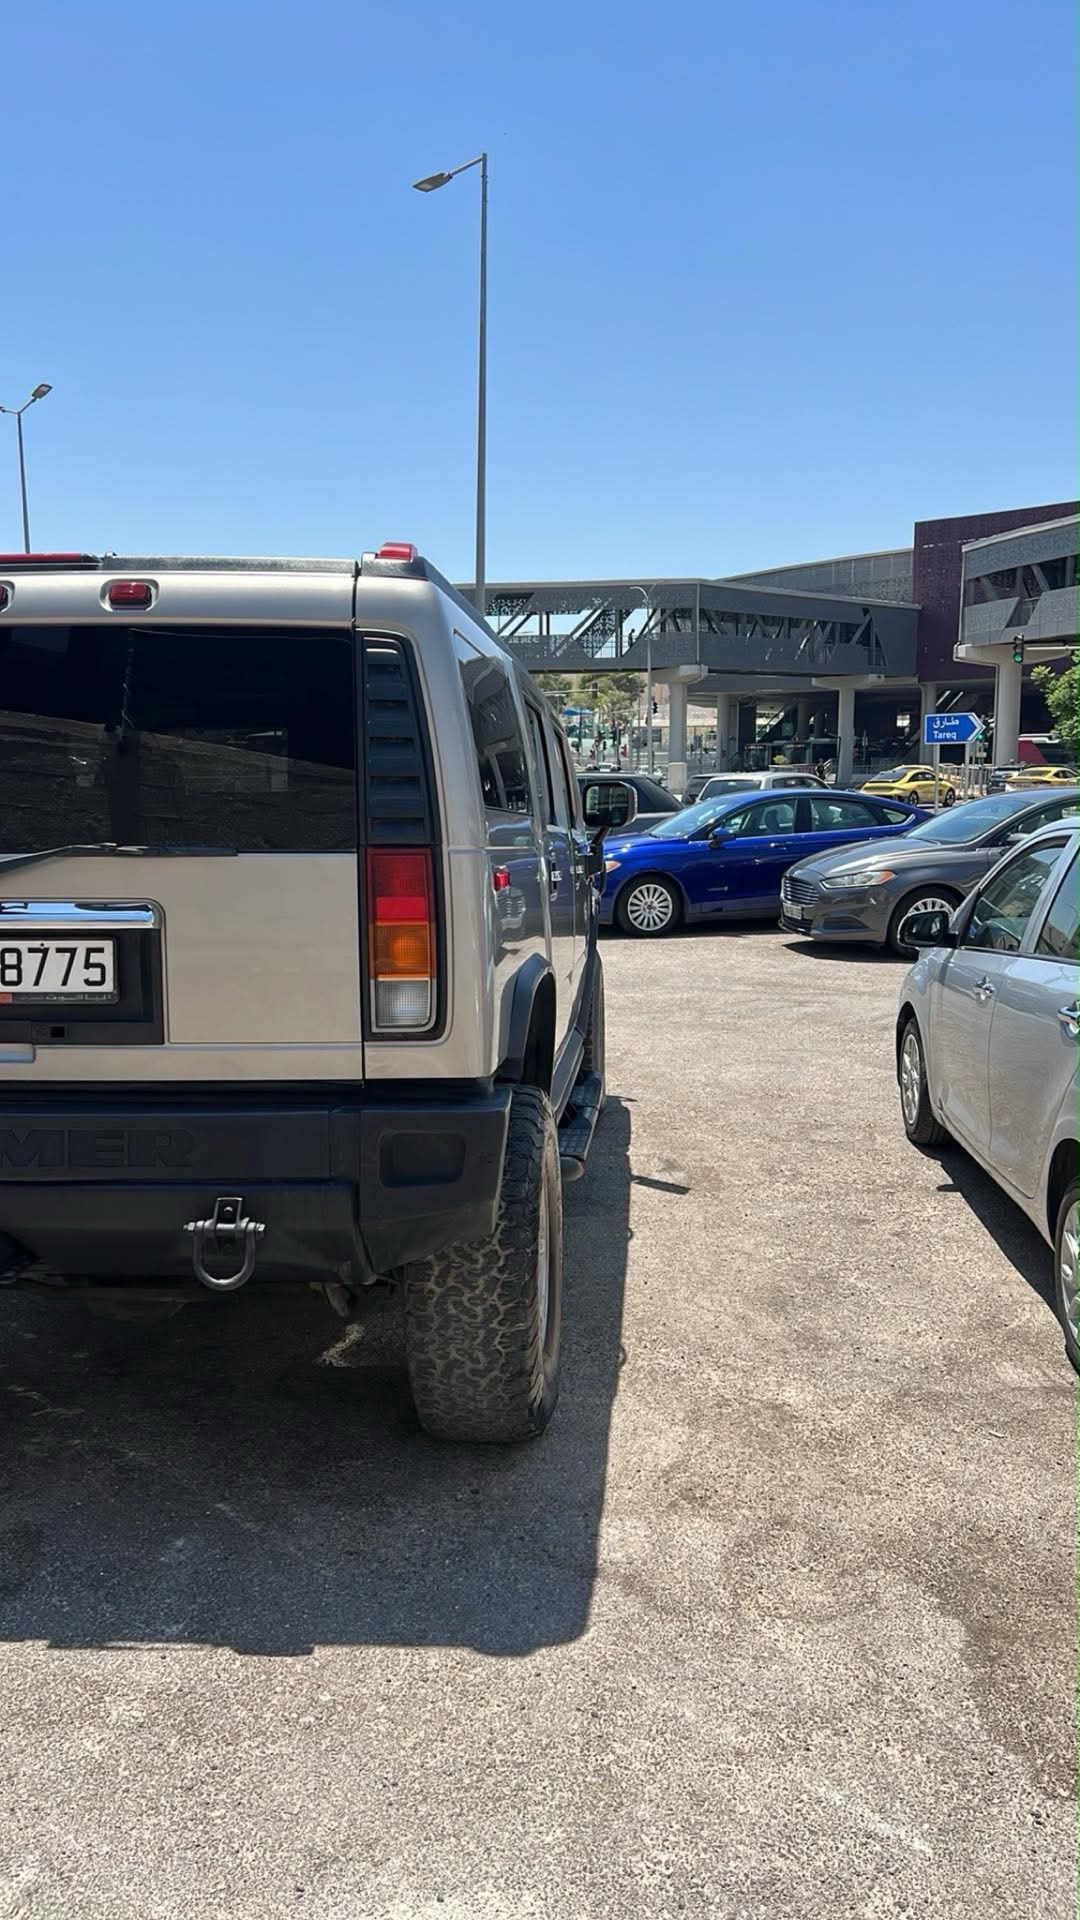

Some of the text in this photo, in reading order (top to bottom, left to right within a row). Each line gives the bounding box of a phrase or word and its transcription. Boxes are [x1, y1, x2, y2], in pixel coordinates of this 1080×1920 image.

[933, 717, 960, 729] طارق
[933, 731, 957, 740] Tareq
[0, 947, 106, 986] 8775
